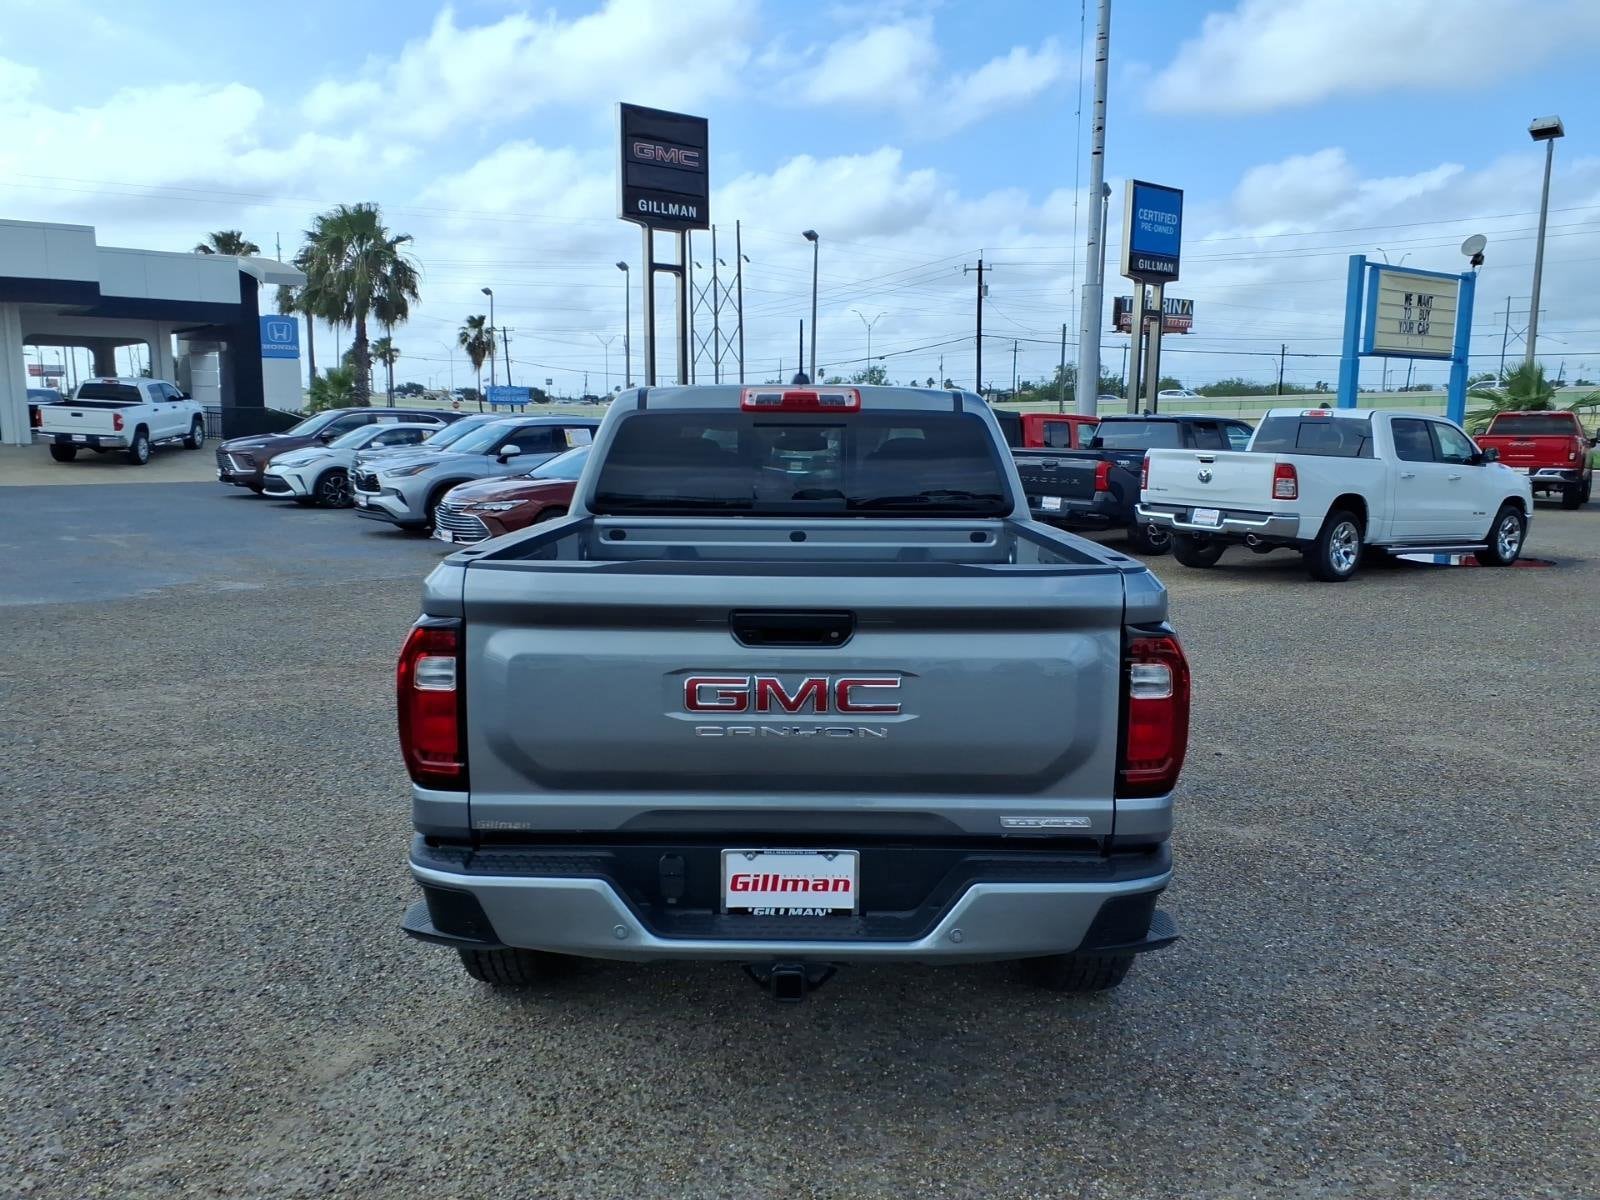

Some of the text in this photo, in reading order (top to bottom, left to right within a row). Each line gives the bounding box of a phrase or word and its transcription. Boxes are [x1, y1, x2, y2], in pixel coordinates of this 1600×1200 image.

[633, 142, 699, 167] GMC
[638, 199, 697, 218] GILLMAN
[1138, 208, 1178, 225] CERTIFIED
[1141, 222, 1175, 235] PRE-OWNED
[1138, 259, 1174, 273] GILLMAN
[1404, 293, 1413, 306] WE
[1404, 306, 1431, 322] TO BUY
[1399, 320, 1430, 335] YOUR CAR
[684, 675, 901, 714] GMC
[695, 726, 888, 738] CANYON
[730, 873, 851, 893] Gillman
